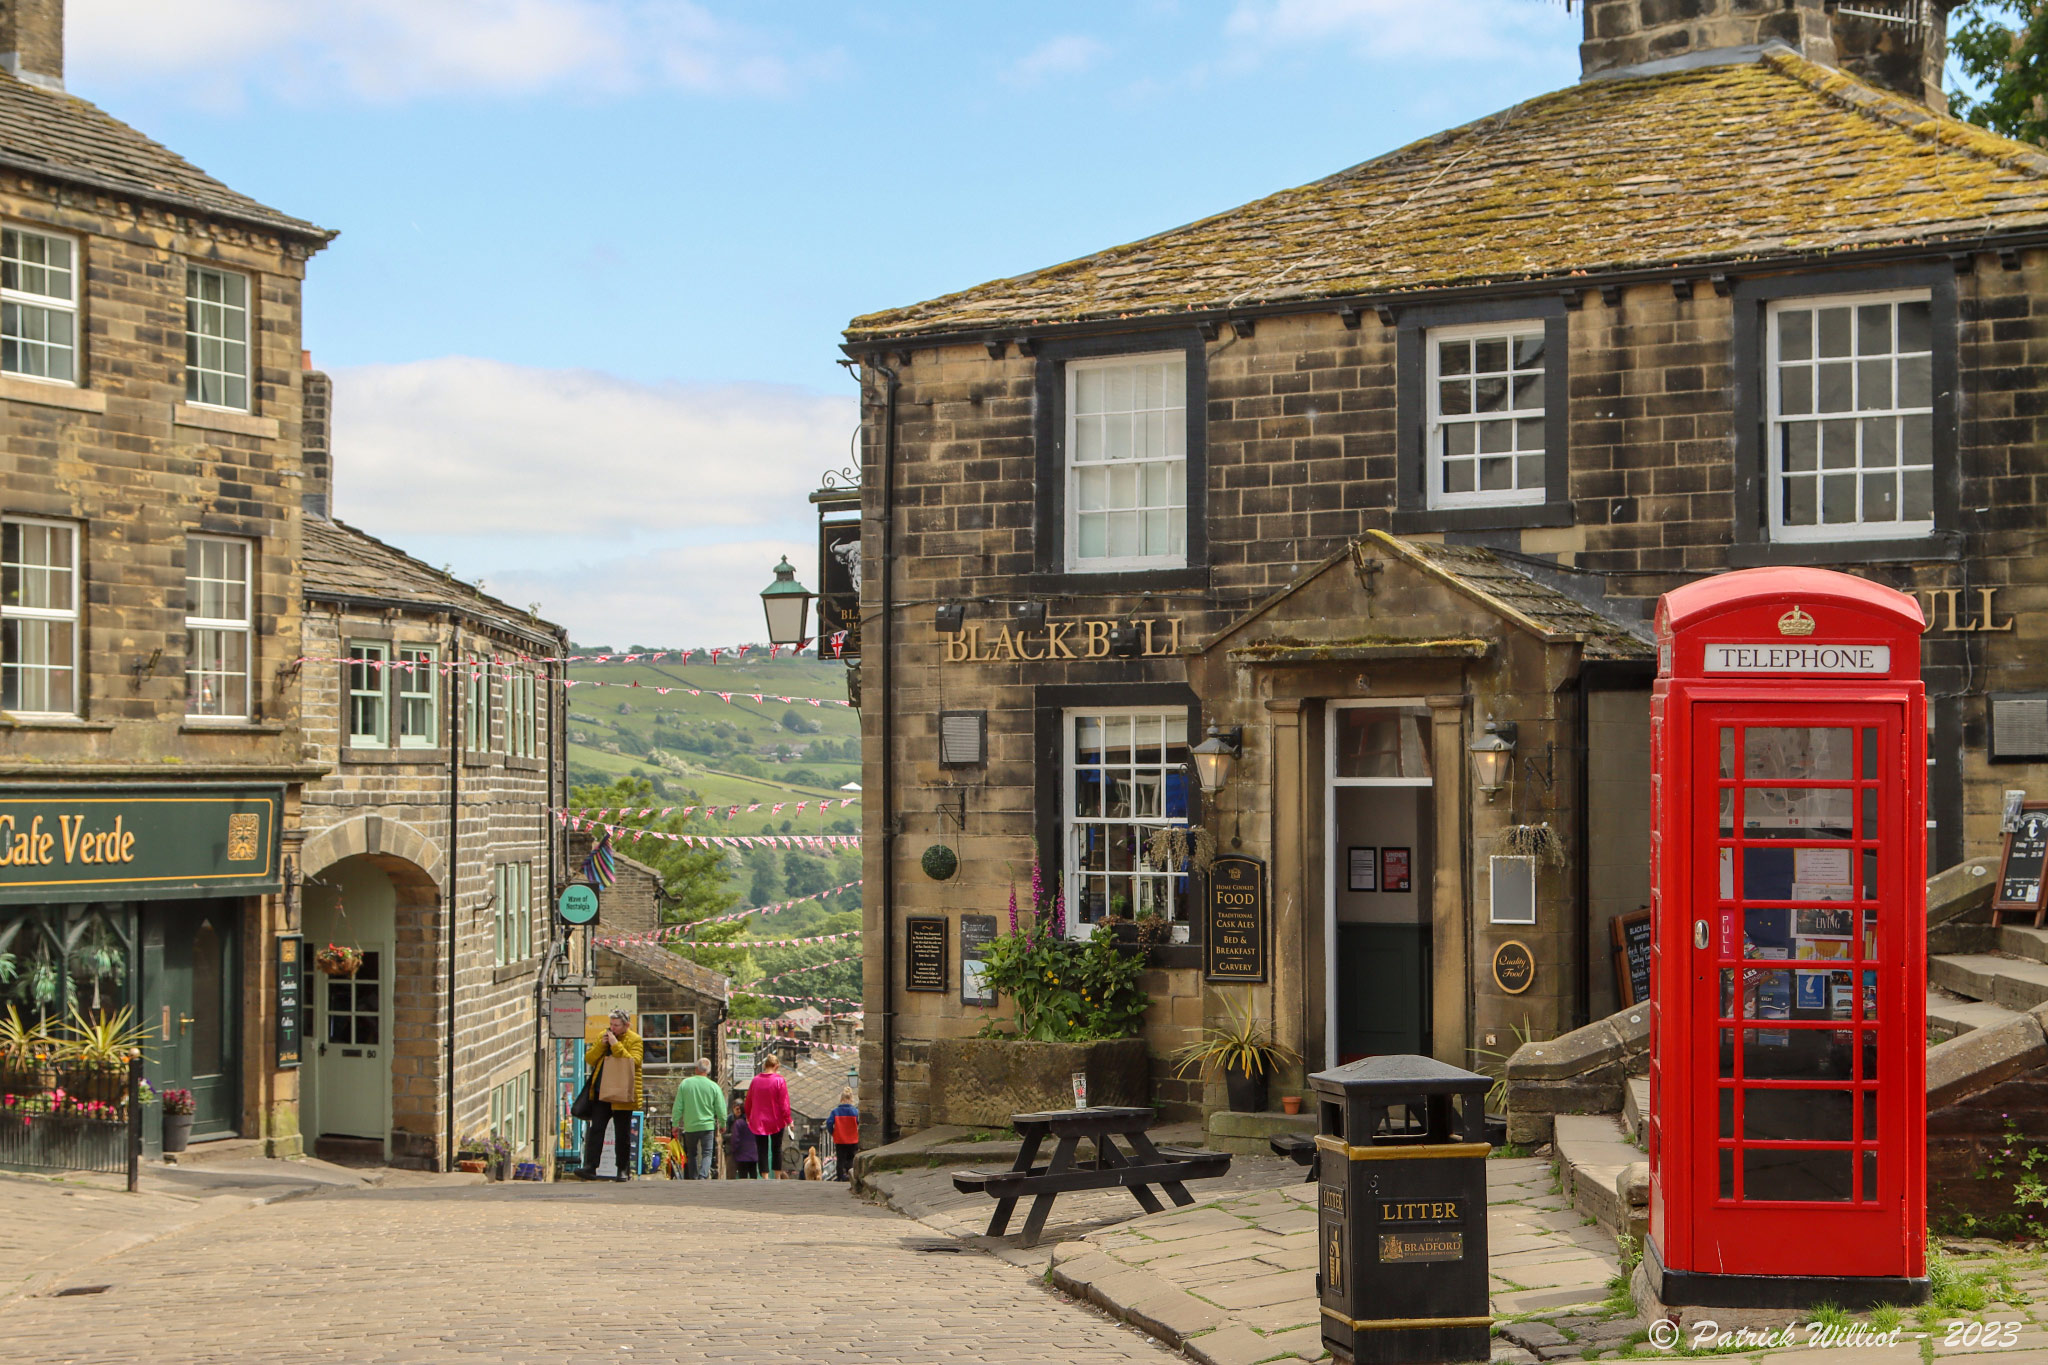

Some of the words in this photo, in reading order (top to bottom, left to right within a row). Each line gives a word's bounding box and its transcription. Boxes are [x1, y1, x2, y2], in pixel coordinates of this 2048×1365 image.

[944, 622, 1078, 663] BLACK
[1718, 648, 1874, 669] TELEPHONE
[0, 814, 54, 867] Cafe
[59, 814, 136, 865] Verde
[582, 895, 589, 903] of
[1216, 891, 1255, 905] FOOD
[566, 902, 591, 911] Nostalgia
[1216, 919, 1236, 929] CASK
[1237, 920, 1255, 929] ALES
[1815, 916, 1840, 929] LIVING
[1223, 935, 1239, 944] BED
[1240, 935, 1248, 945] &
[1722, 915, 1730, 954] PULL
[1216, 945, 1256, 955] BREAKFAST
[1219, 962, 1253, 971] CARVERY
[1498, 954, 1528, 969] Quality
[1502, 967, 1526, 978] Food
[1382, 1202, 1459, 1220] LITTER
[1404, 1241, 1461, 1252] BRADFORD
